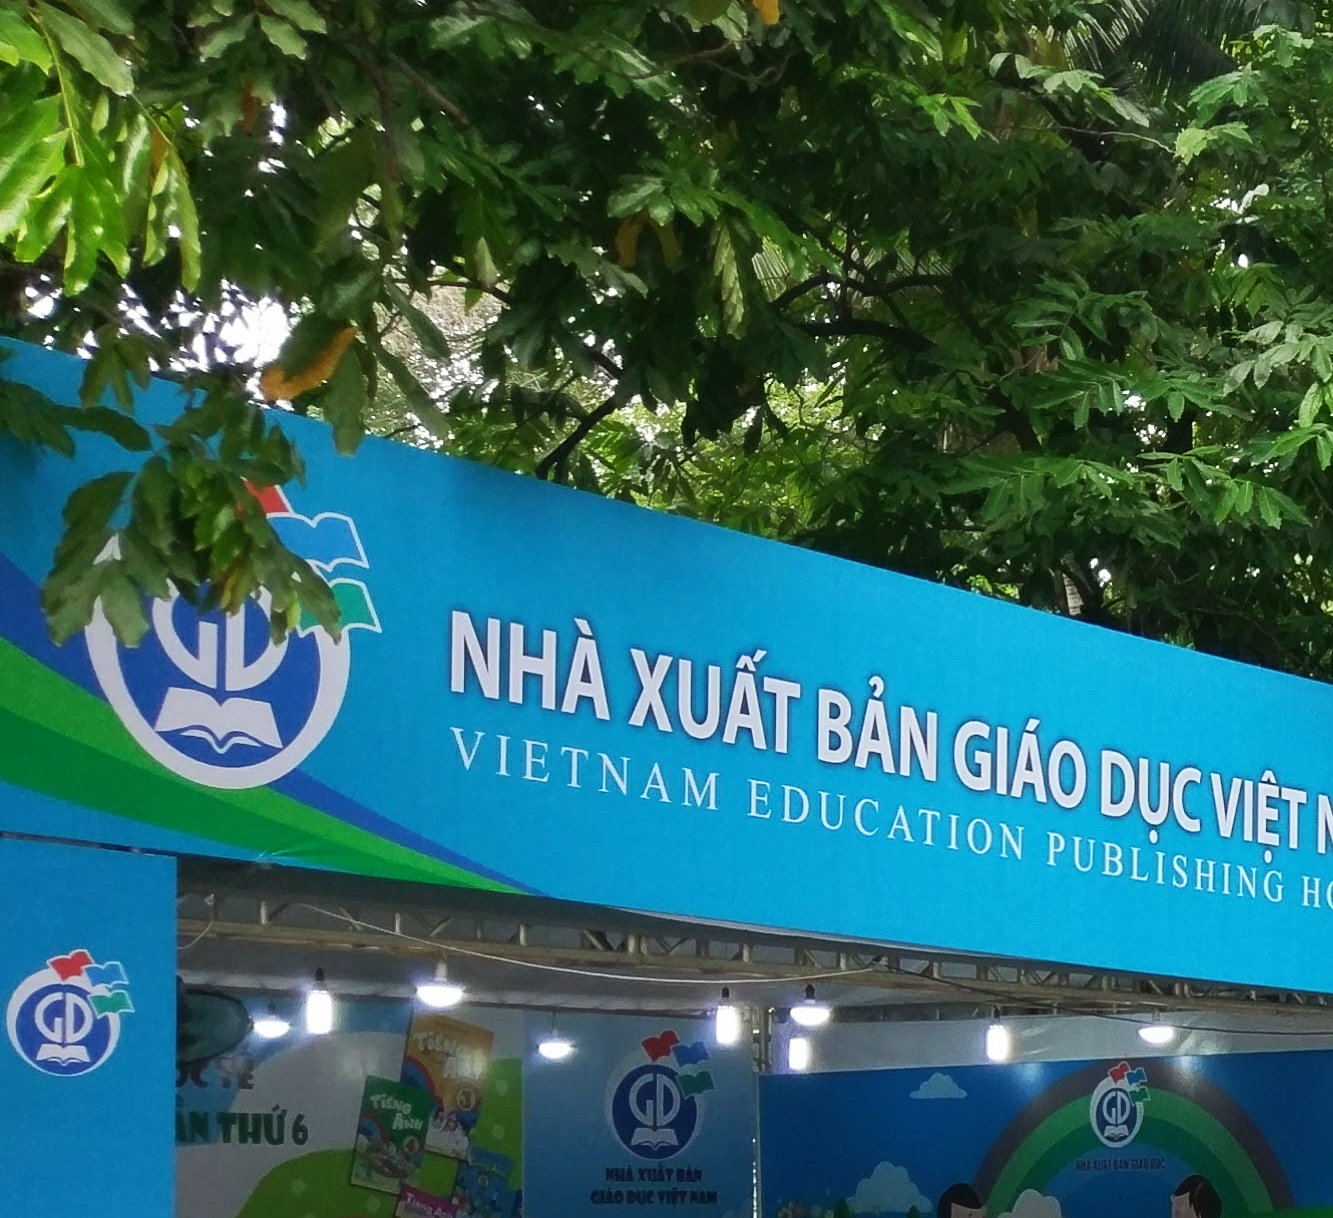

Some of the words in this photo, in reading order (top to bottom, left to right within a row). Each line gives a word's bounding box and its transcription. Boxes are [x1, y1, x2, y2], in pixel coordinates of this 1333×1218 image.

[450, 727, 719, 811] VIETNAM
[748, 780, 1024, 860] EDUCATION
[1047, 832, 1284, 903] PUBLISHING
[451, 611, 609, 721] NHÀ
[630, 649, 800, 753] XUẤT
[818, 675, 937, 782] BẢN
[954, 719, 1086, 808] GIÁO
[1101, 750, 1202, 843] DỤC
[1211, 770, 1306, 863] VIỆT
[216, 1103, 288, 1146] THỨ
[292, 1113, 309, 1146] 6
